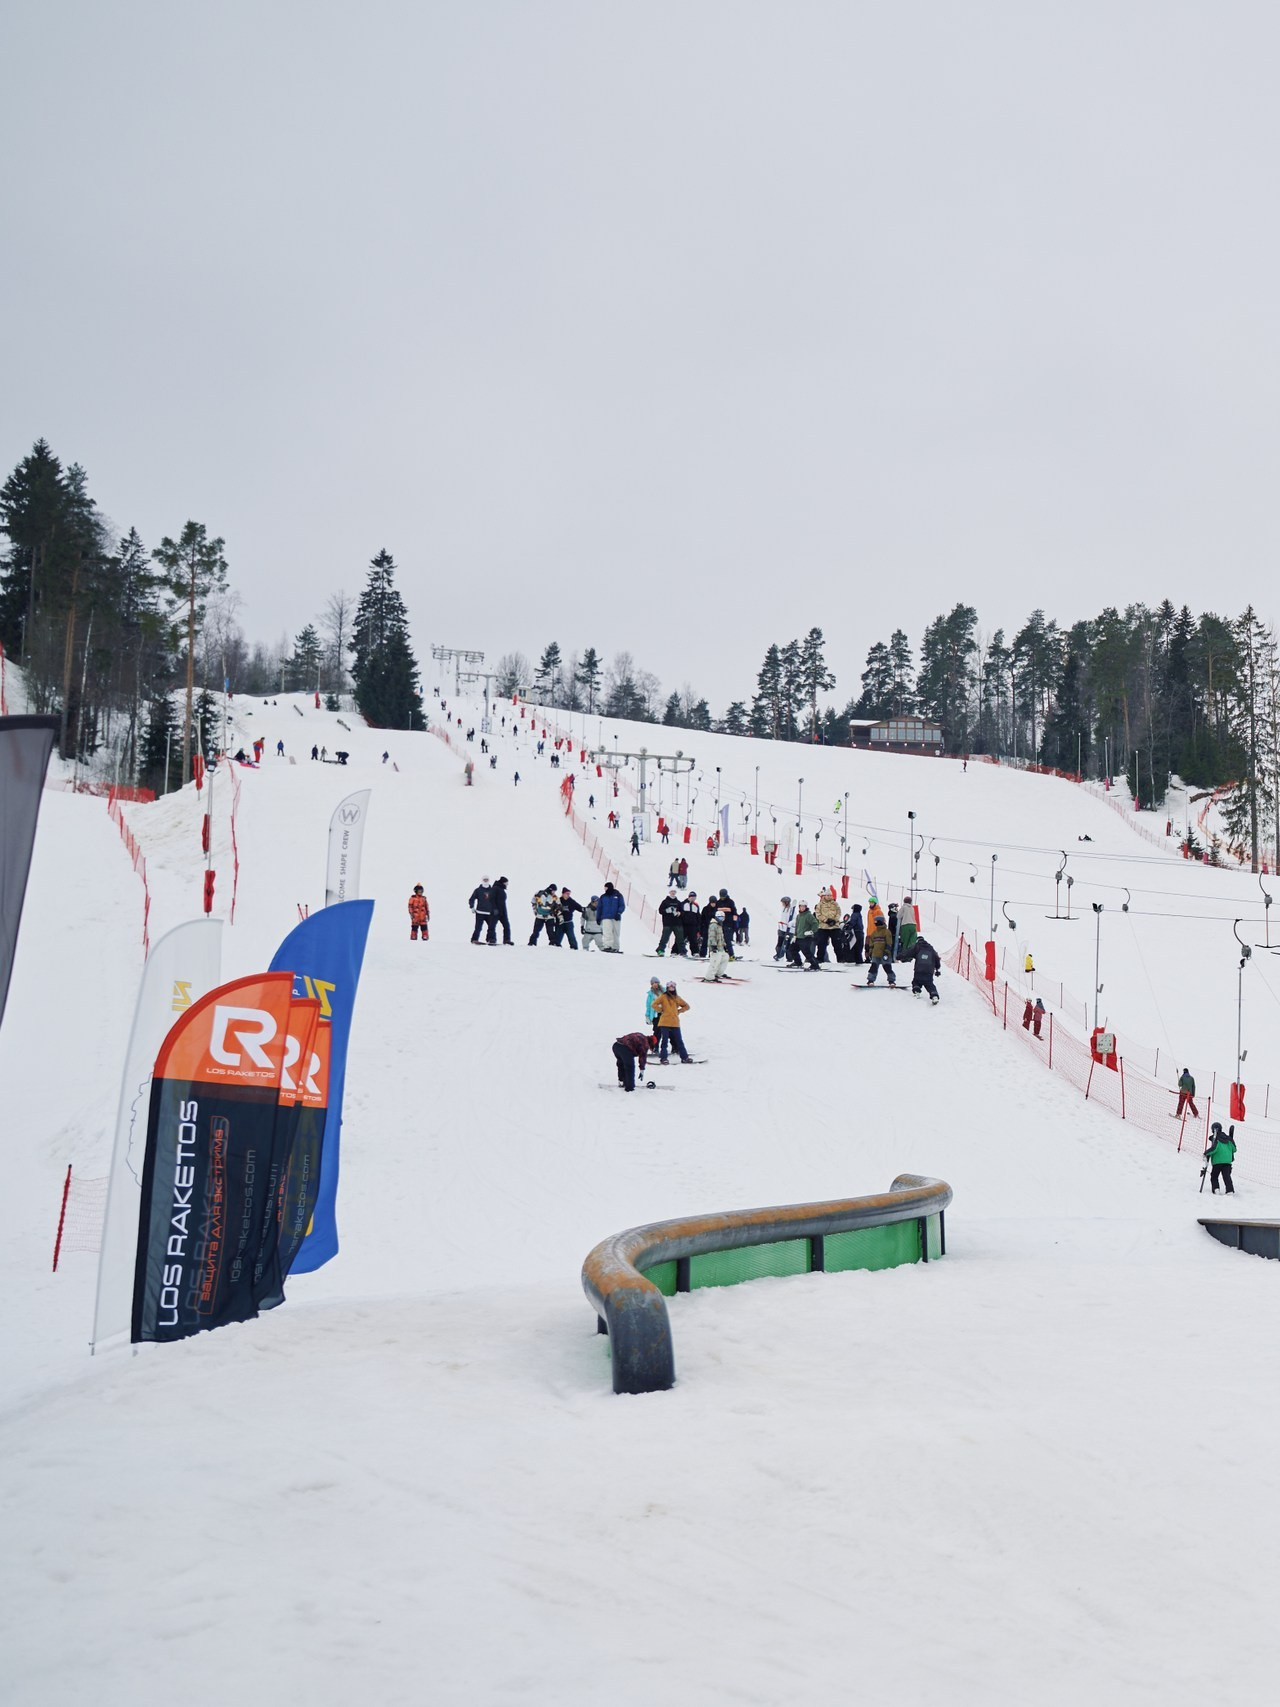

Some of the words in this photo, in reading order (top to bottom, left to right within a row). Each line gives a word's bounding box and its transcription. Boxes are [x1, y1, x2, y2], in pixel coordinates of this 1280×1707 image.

[342, 829, 350, 850] CREW
[206, 1067, 226, 1076] LOS
[227, 1068, 276, 1079] RAKETOS
[167, 1100, 198, 1256] RAKETOS
[159, 1264, 183, 1326] LOS
